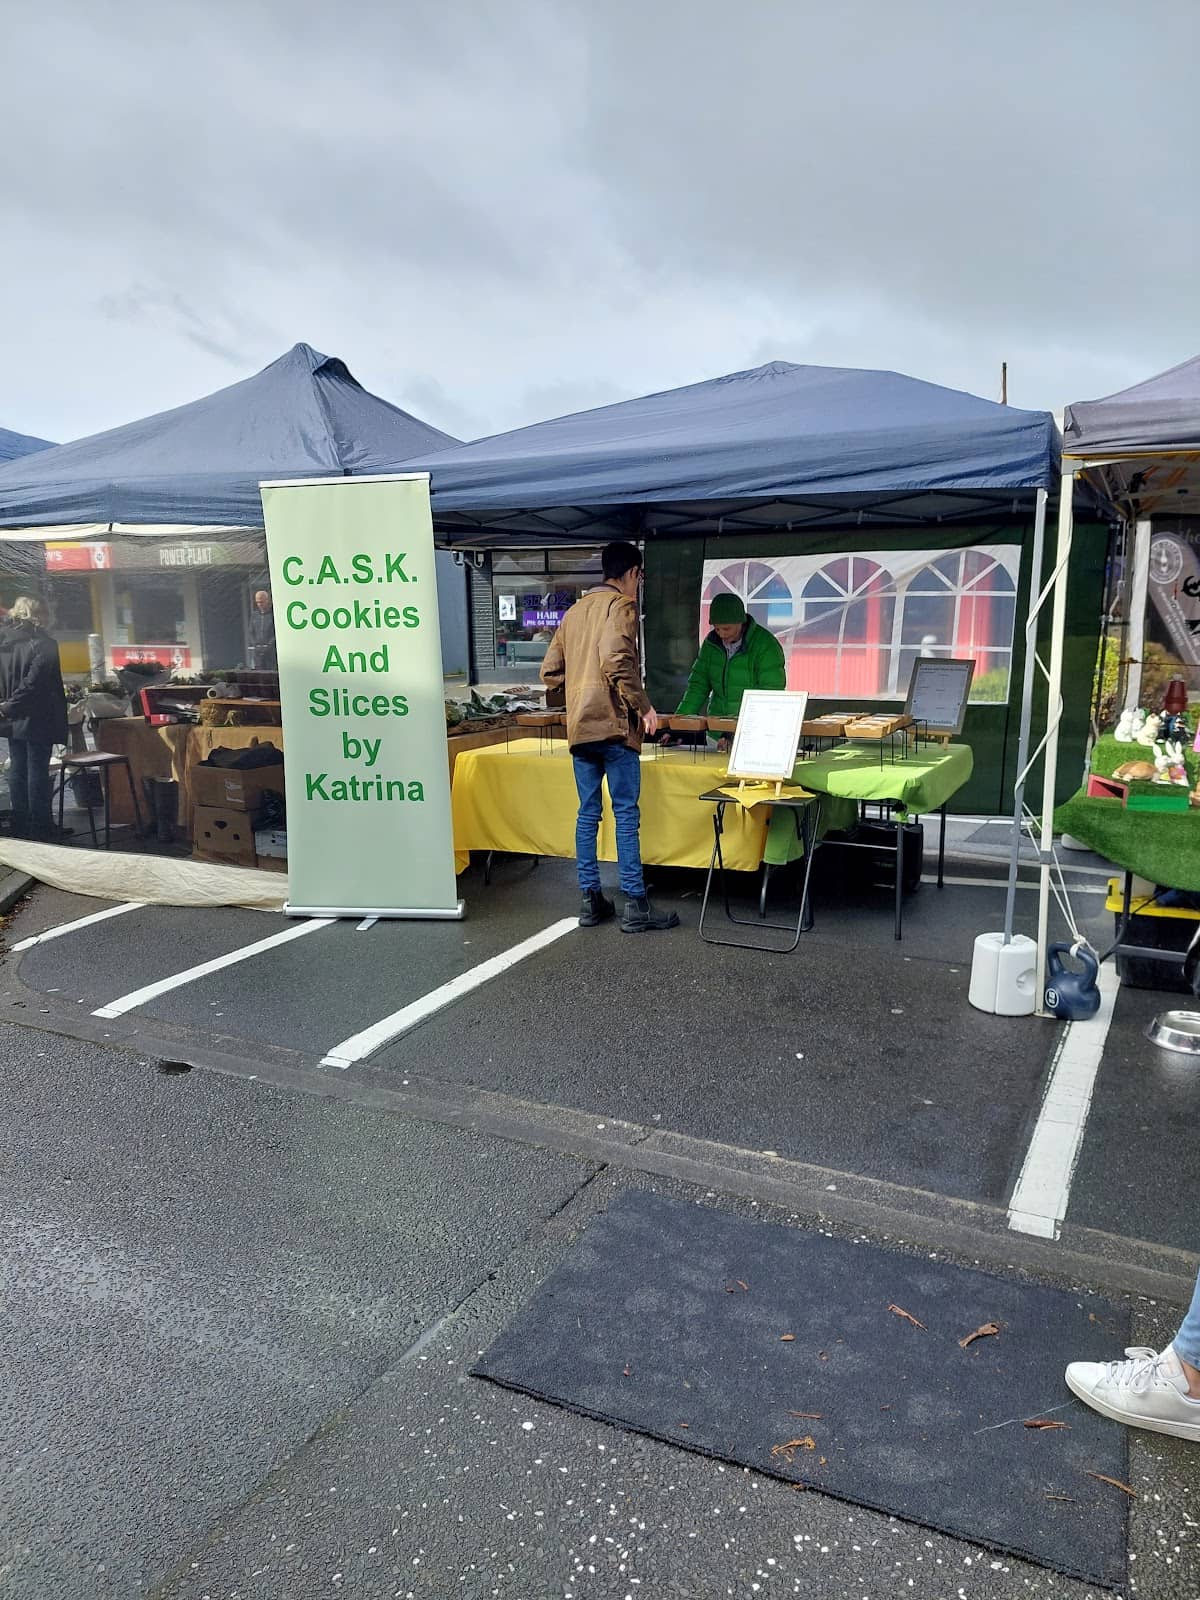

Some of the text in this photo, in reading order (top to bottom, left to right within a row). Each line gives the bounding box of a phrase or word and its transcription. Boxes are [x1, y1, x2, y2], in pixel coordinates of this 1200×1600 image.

[160, 547, 212, 566] POWER PLANT
[282, 552, 418, 587] C.A.S.K.
[286, 599, 421, 631] Cookies
[536, 611, 558, 619] HAIR
[323, 643, 390, 673] And
[309, 688, 410, 718] Slices
[342, 732, 382, 766] by
[305, 773, 425, 802] Katrina
